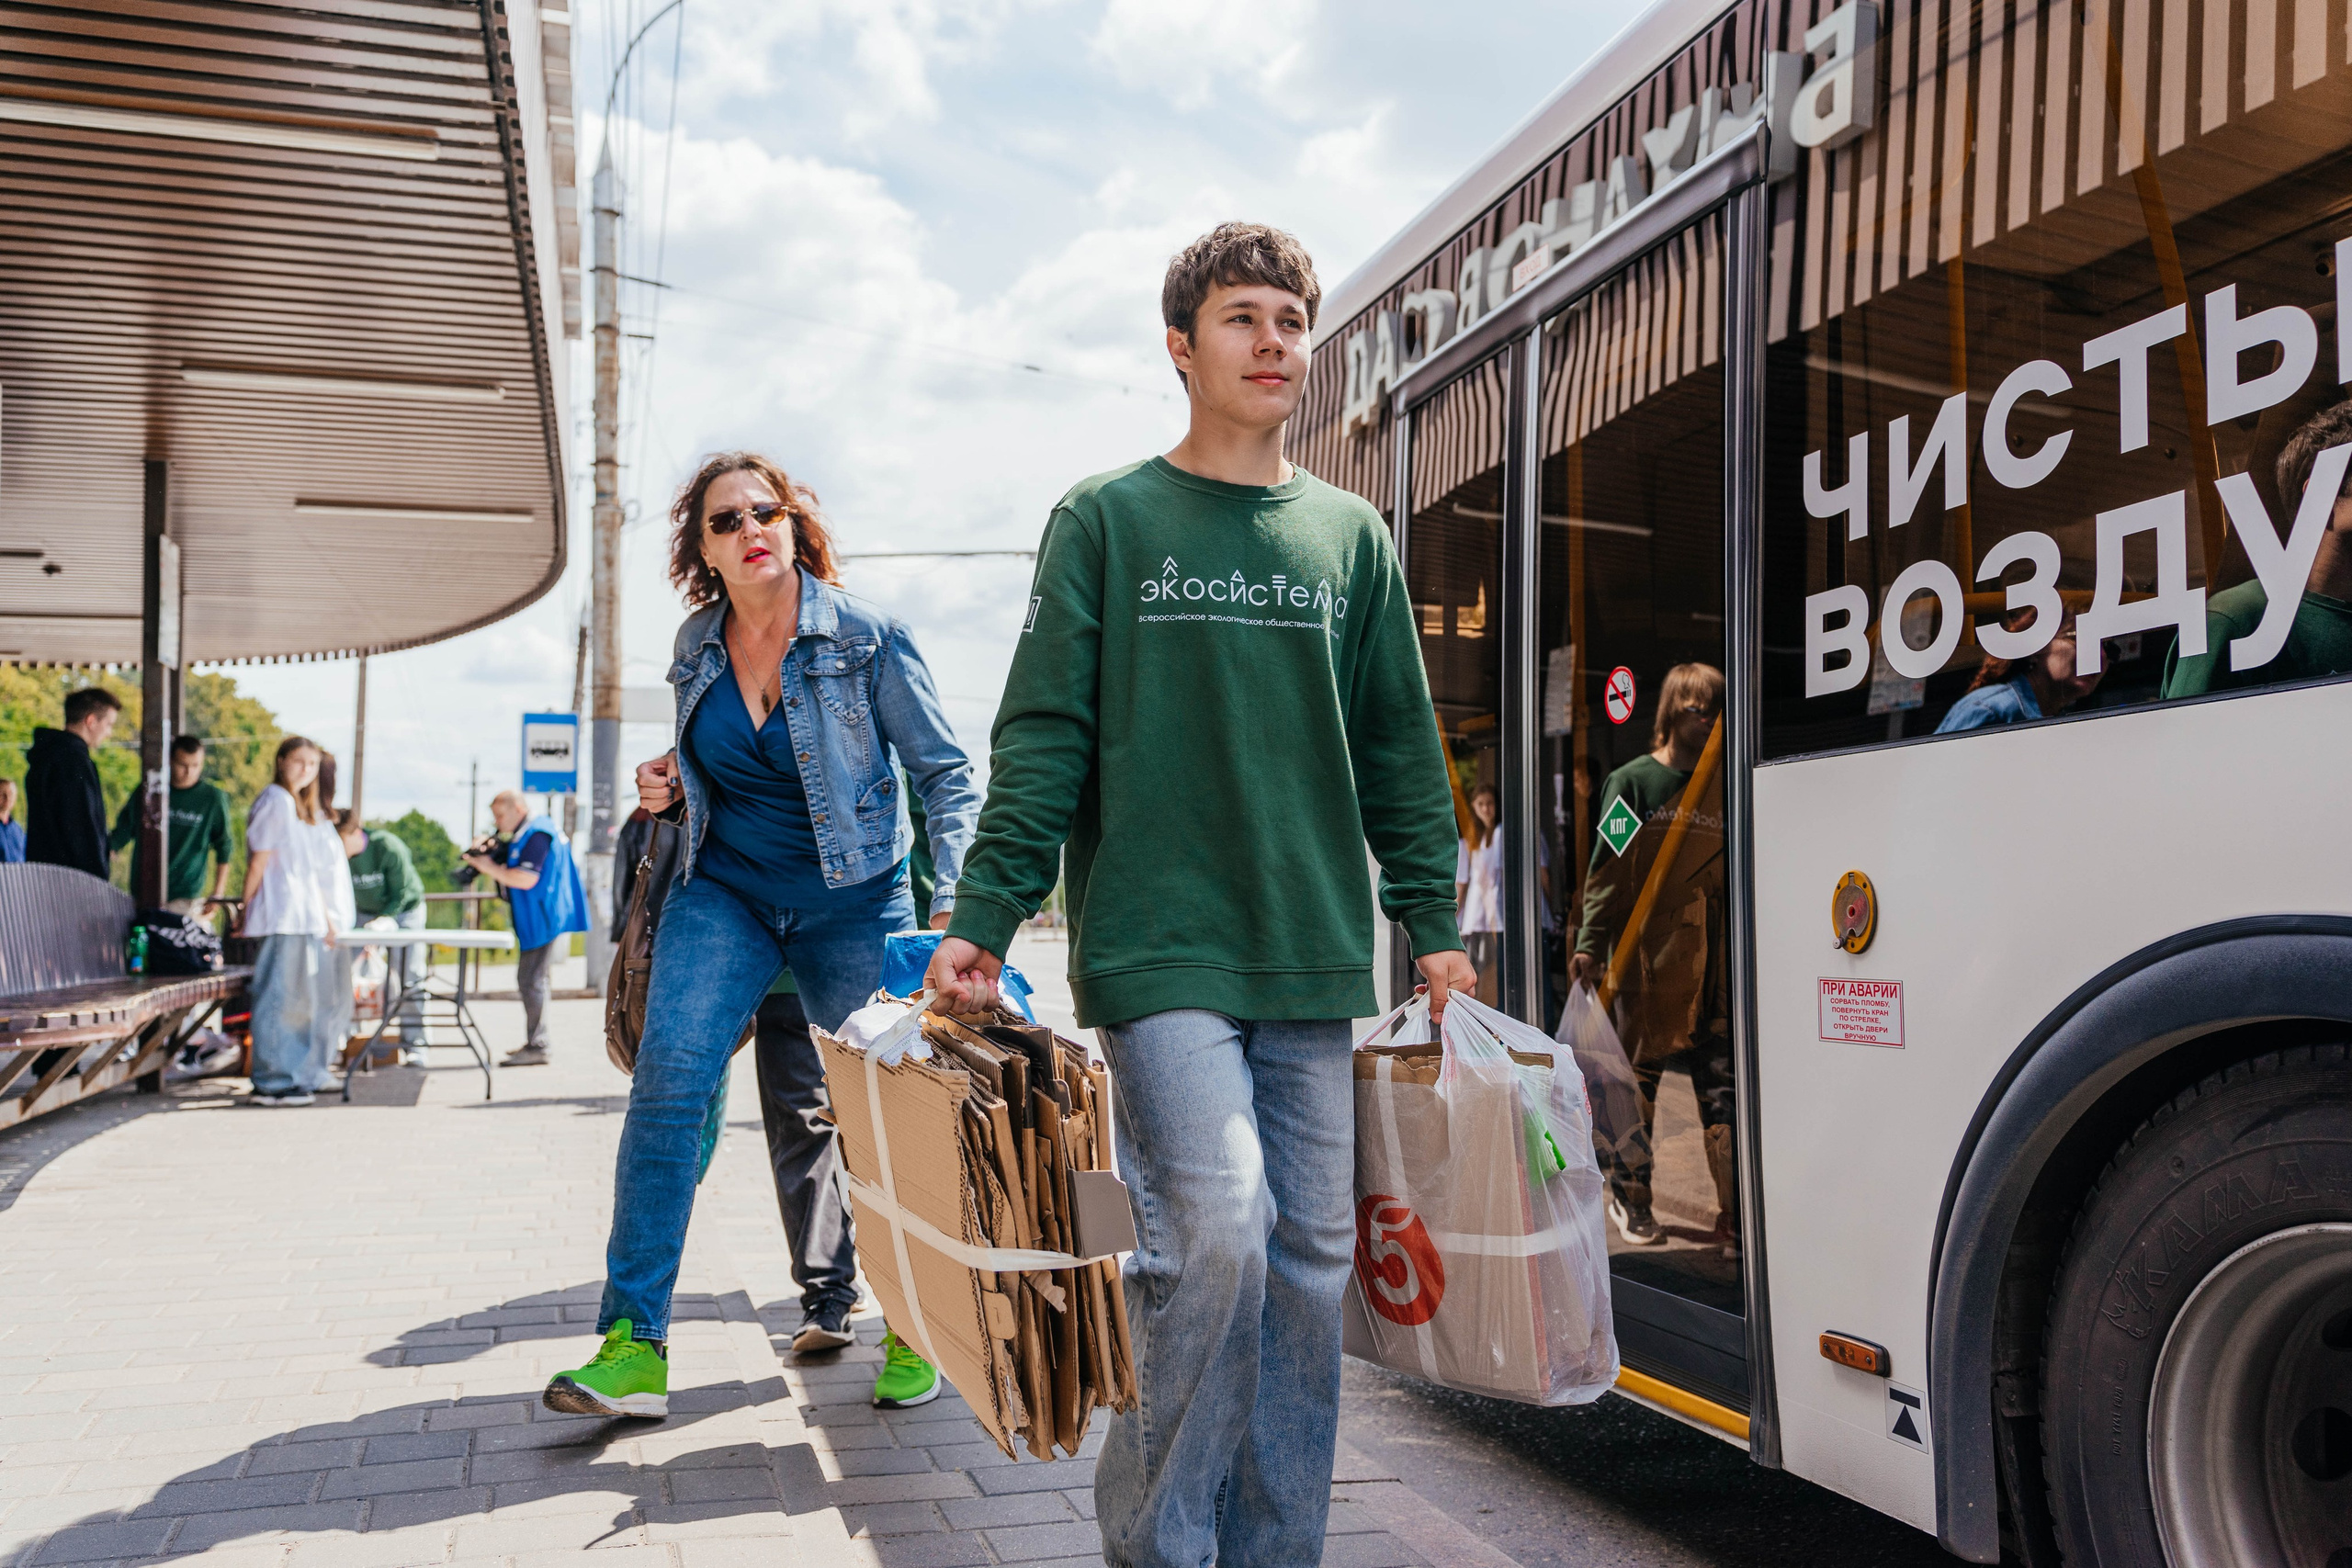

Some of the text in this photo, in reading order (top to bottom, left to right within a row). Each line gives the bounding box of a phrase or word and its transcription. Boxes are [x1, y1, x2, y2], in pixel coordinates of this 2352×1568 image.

[1207, 615, 1264, 626] экологическое
[1265, 617, 1326, 630] общественное
[1610, 816, 1628, 836] КПГ
[1822, 981, 1897, 998] ПРИ АВАРИИ
[1830, 998, 1891, 1008] СОРВАТЬ ПЛОМБУ,
[1831, 1007, 1870, 1015] ПОВЕРНУТЬ
[1849, 1015, 1881, 1024] СТРЕЛКЕ,
[1833, 1022, 1888, 1033] ОТКРЫТЬ ДВЕРИ
[1844, 1032, 1876, 1041] ВРУЧНУЮ
